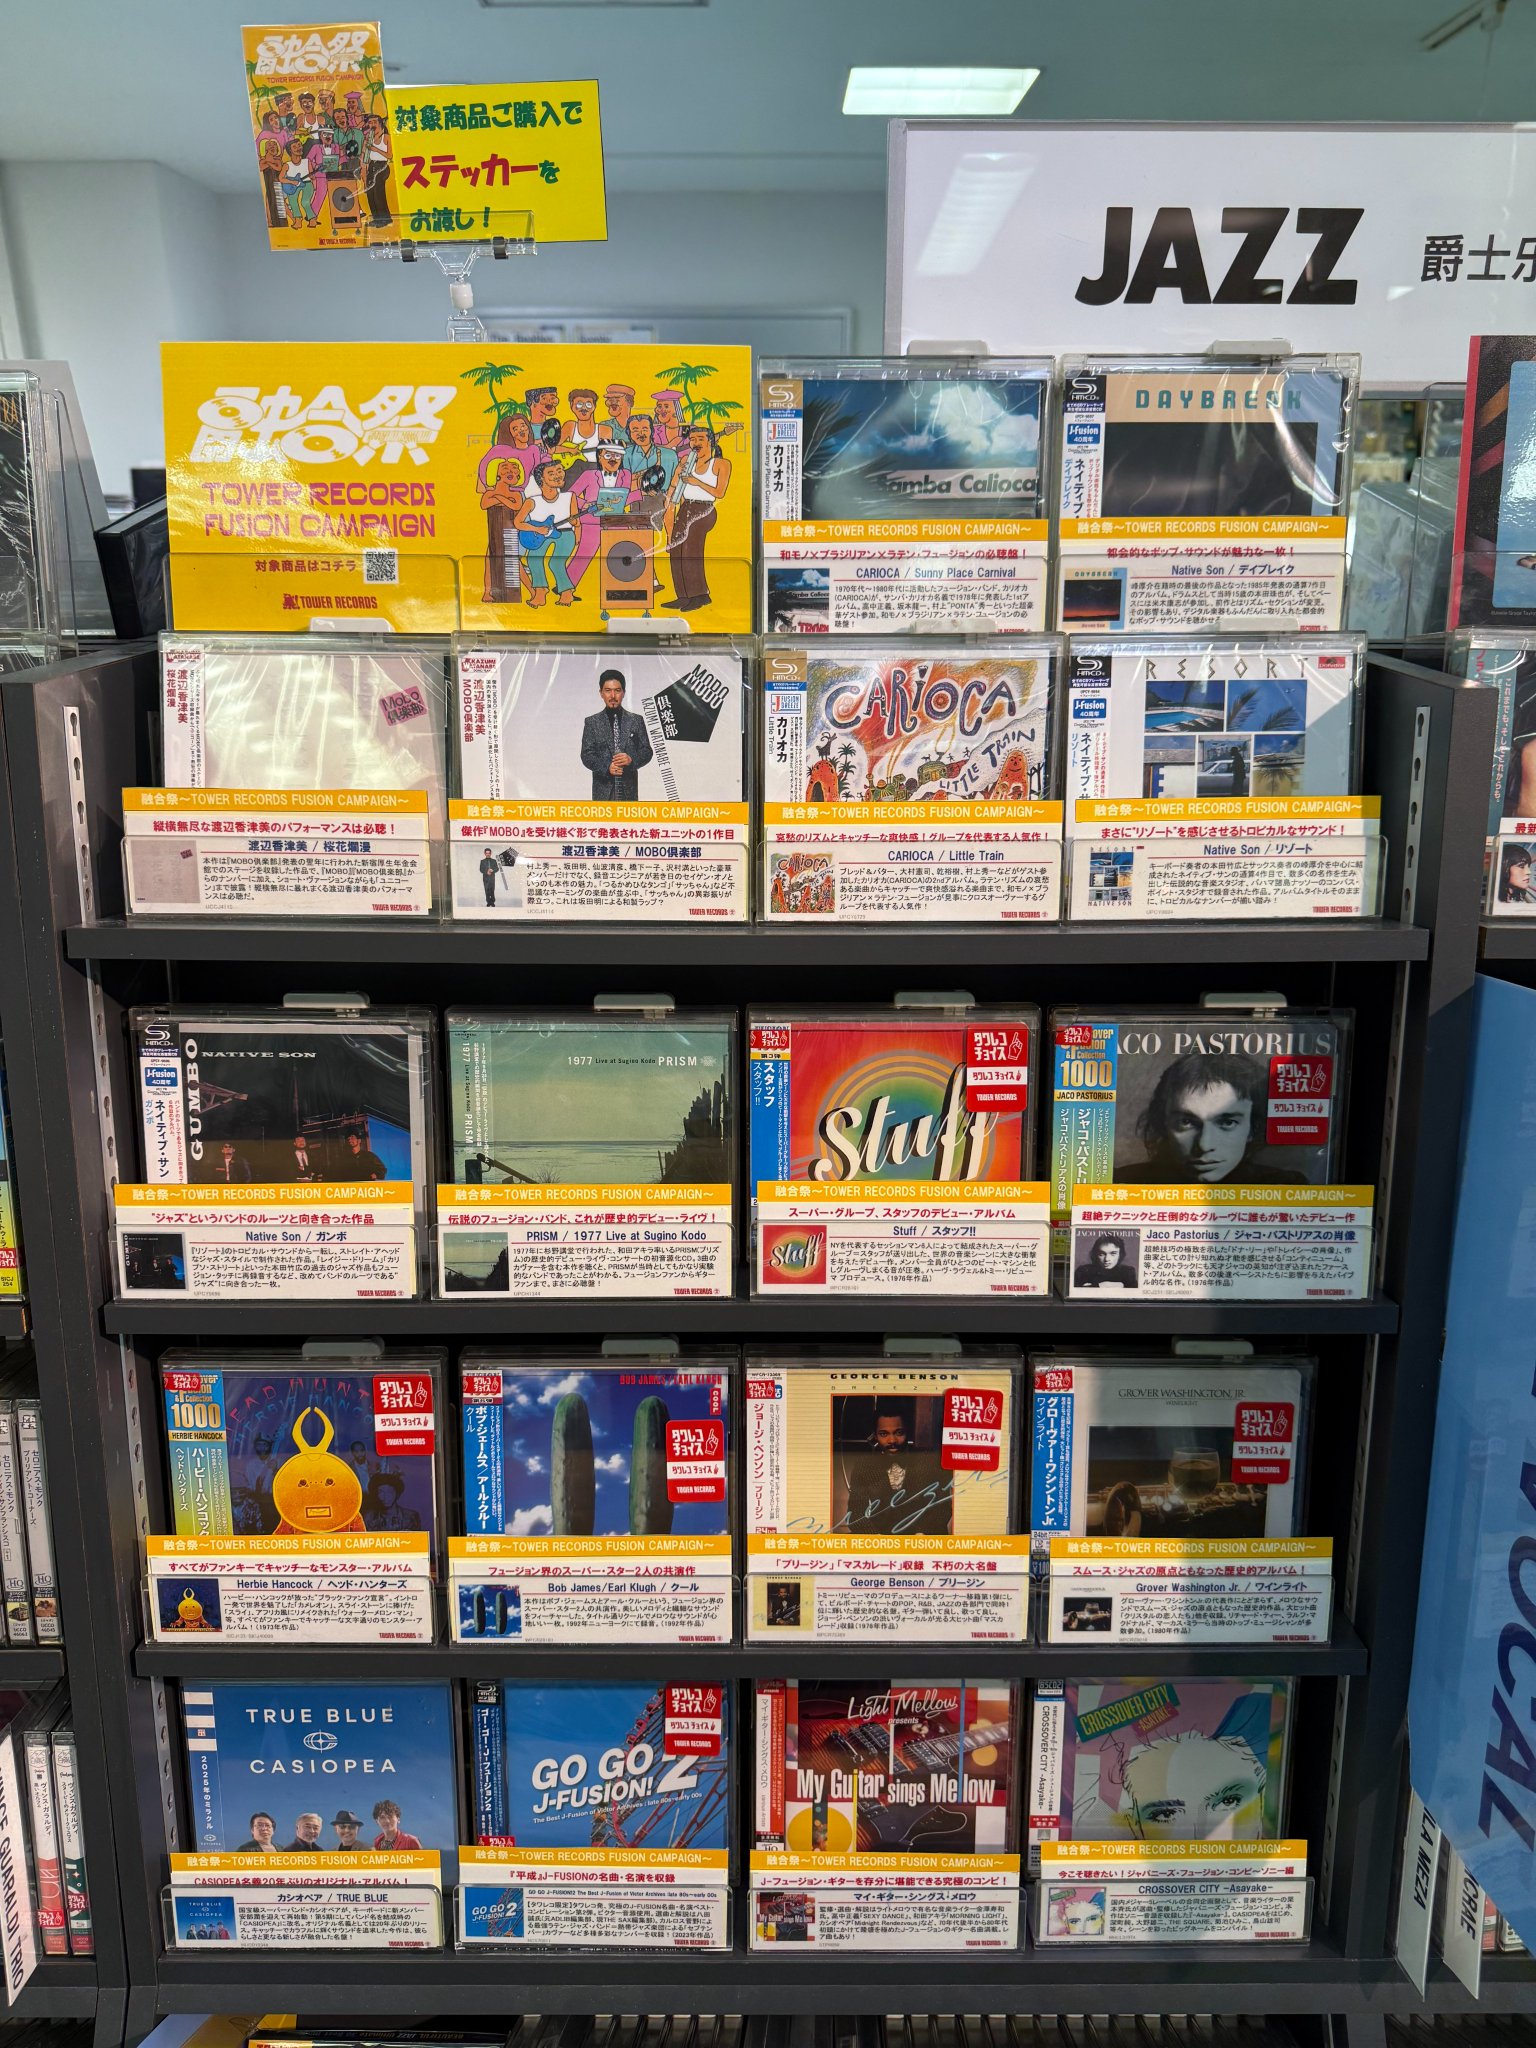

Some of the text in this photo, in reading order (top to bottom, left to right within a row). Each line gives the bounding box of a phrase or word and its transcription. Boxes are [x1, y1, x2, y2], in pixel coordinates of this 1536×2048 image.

[395, 100, 583, 133] 対象商品ご購入で
[401, 154, 559, 189] ステッカーを
[410, 207, 491, 234] お渡し！
[1075, 207, 1365, 305] JAZZ
[1136, 389, 1302, 409] DAYBREAK
[1069, 425, 1099, 435] J-Fusion
[773, 444, 784, 493] カリオカ
[202, 482, 436, 506] TOWER RECORDS
[959, 474, 1036, 494] Calioca
[1064, 459, 1073, 509] デイブレイク
[204, 513, 436, 537] FUSION CAMPAIGN
[255, 560, 356, 572] 対象商品はコチラ
[856, 568, 900, 578] CARIOCA
[915, 568, 944, 579] Sunny
[947, 567, 973, 578] Place
[977, 567, 1016, 578] Carnival
[1172, 565, 1202, 575] Native
[1206, 565, 1225, 575] Son
[1239, 565, 1295, 575] デイブレイク
[300, 596, 377, 609] TOWER RECORDS
[1146, 658, 1308, 680] RESORT
[167, 669, 176, 708] 桜花爛漫
[463, 678, 474, 743] MOBO倶楽部
[824, 668, 1016, 737] CARIOCA
[1075, 700, 1105, 711] J-Fusion
[657, 696, 678, 738] 倶楽部
[641, 697, 670, 768] KAZUMI WATANABE
[776, 717, 788, 763] カリオカ
[939, 727, 1036, 793] LITTLE TRAIN
[234, 794, 288, 806] RECORDS
[291, 794, 334, 807] FUSION
[635, 846, 702, 858] MOBO倶楽部
[888, 851, 934, 861] CARIOCA
[950, 851, 975, 861] Little
[979, 851, 1004, 861] Train
[974, 1032, 1007, 1045] タワレコ
[1116, 1031, 1332, 1056] CO PASTORIUS
[567, 1057, 592, 1066] 1977
[658, 1056, 697, 1066] PRISM
[974, 1046, 1007, 1061] チョイス
[764, 1062, 775, 1108] スタッフ
[1060, 1060, 1112, 1088] 1000
[1057, 1091, 1113, 1100] JACO PASTORIUS
[145, 1100, 155, 1124] ガンボ
[808, 1061, 999, 1180] Stuff
[156, 1100, 170, 1178] ネイティブ・サン
[788, 1207, 1016, 1219] スーパー・グループ、スタッフのデビュー・アルバム
[893, 1226, 916, 1236] Stuff
[1118, 1388, 1159, 1398] GROVER
[1160, 1388, 1232, 1398] WASHINGTON,
[170, 1403, 221, 1429] 1000
[465, 1407, 475, 1432] クール
[753, 1403, 765, 1479] ジョージ・ベンソン
[175, 1447, 188, 1511] ヘッド・ハンターズ
[169, 1562, 412, 1573] すべてがファンキーでキャッチーなモンスター・アルバム
[488, 1566, 695, 1577] フュージョン界のスーパー・スター2人の共演作
[932, 1561, 997, 1571] 不朽の大名盤
[245, 1708, 394, 1723] TRUE BLUE
[848, 1690, 958, 1720] Light Mellow
[1079, 1688, 1171, 1737] CROSSOVER CITY
[888, 1717, 919, 1725] presents
[250, 1759, 396, 1774] CASIOPEA
[532, 1743, 655, 1791] GO GO
[201, 1755, 213, 1830] 2025年のミラクル
[533, 1754, 700, 1813] J-FUSION! 2
[797, 1768, 996, 1807] My Guitar sings Mellow
[1138, 1885, 1195, 1894] CROSSOVER
[1199, 1884, 1220, 1893] CITY
[1413, 1860, 1432, 1910] MEZA
[0, 1837, 20, 1936] GUARALDI
[12, 1936, 24, 1990] TRIO
